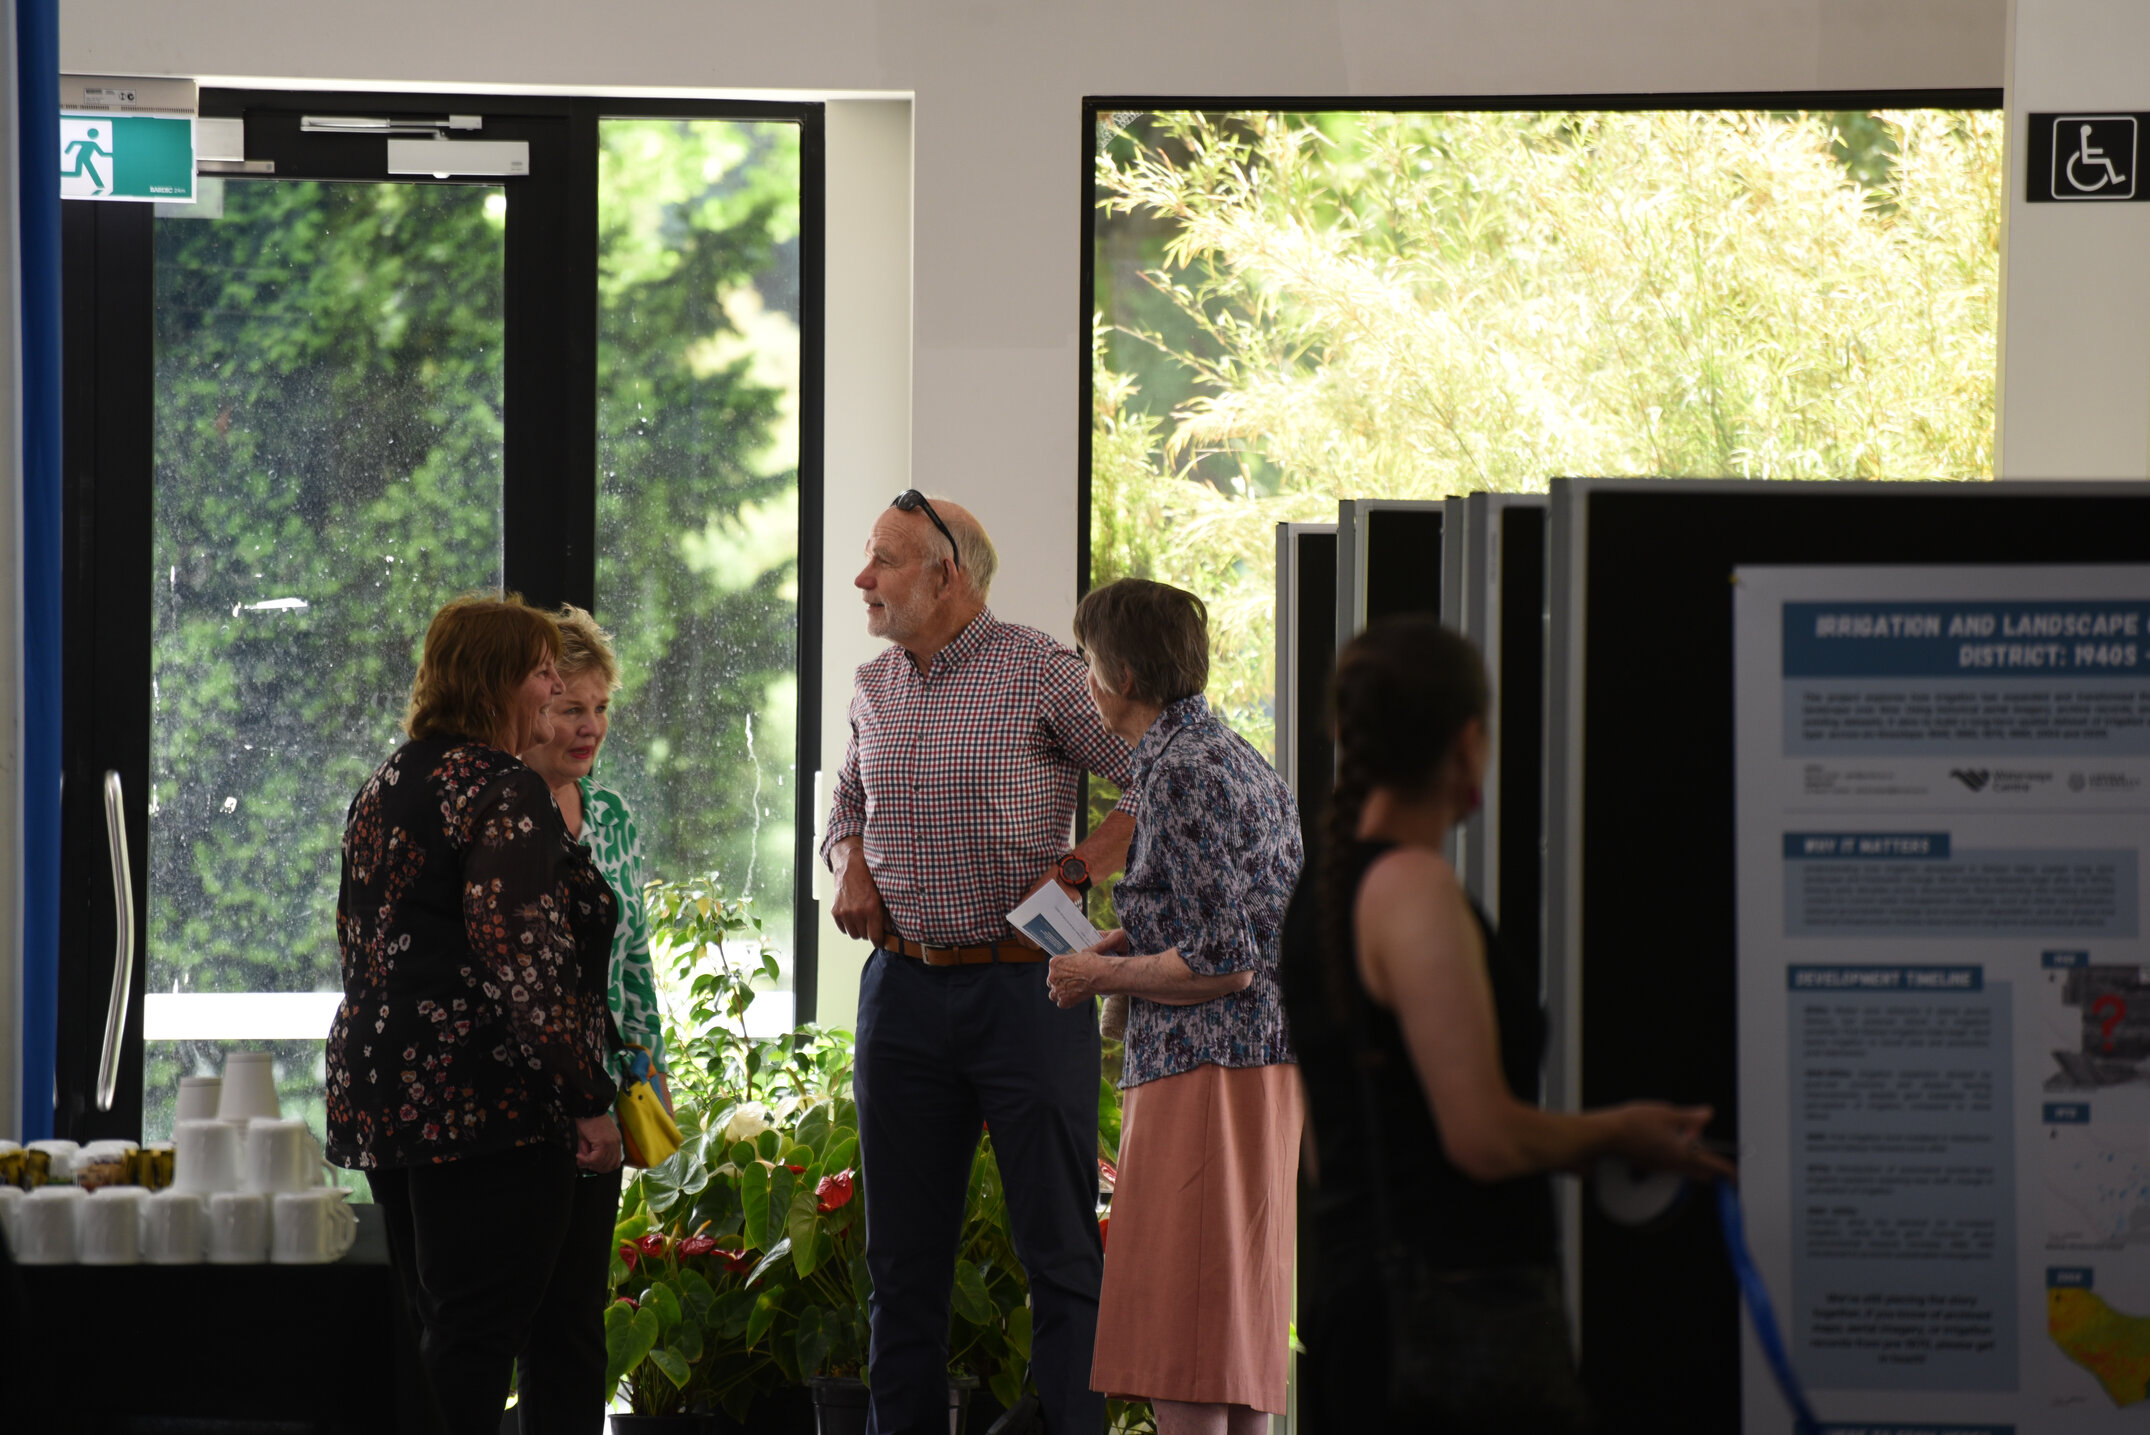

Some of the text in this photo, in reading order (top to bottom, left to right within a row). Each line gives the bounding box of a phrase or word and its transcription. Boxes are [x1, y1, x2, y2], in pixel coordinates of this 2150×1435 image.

[1815, 614, 1941, 638] IRRIGATION
[1948, 613, 1995, 638] AND
[2003, 613, 2139, 638] LANDSCAPE
[1959, 644, 2067, 668] DISTRICT:
[2074, 644, 2138, 668] 1940S
[1804, 838, 1931, 855] WHY IT MATTERS
[1795, 969, 1972, 988] DEVELOPMENT TIMELINE
